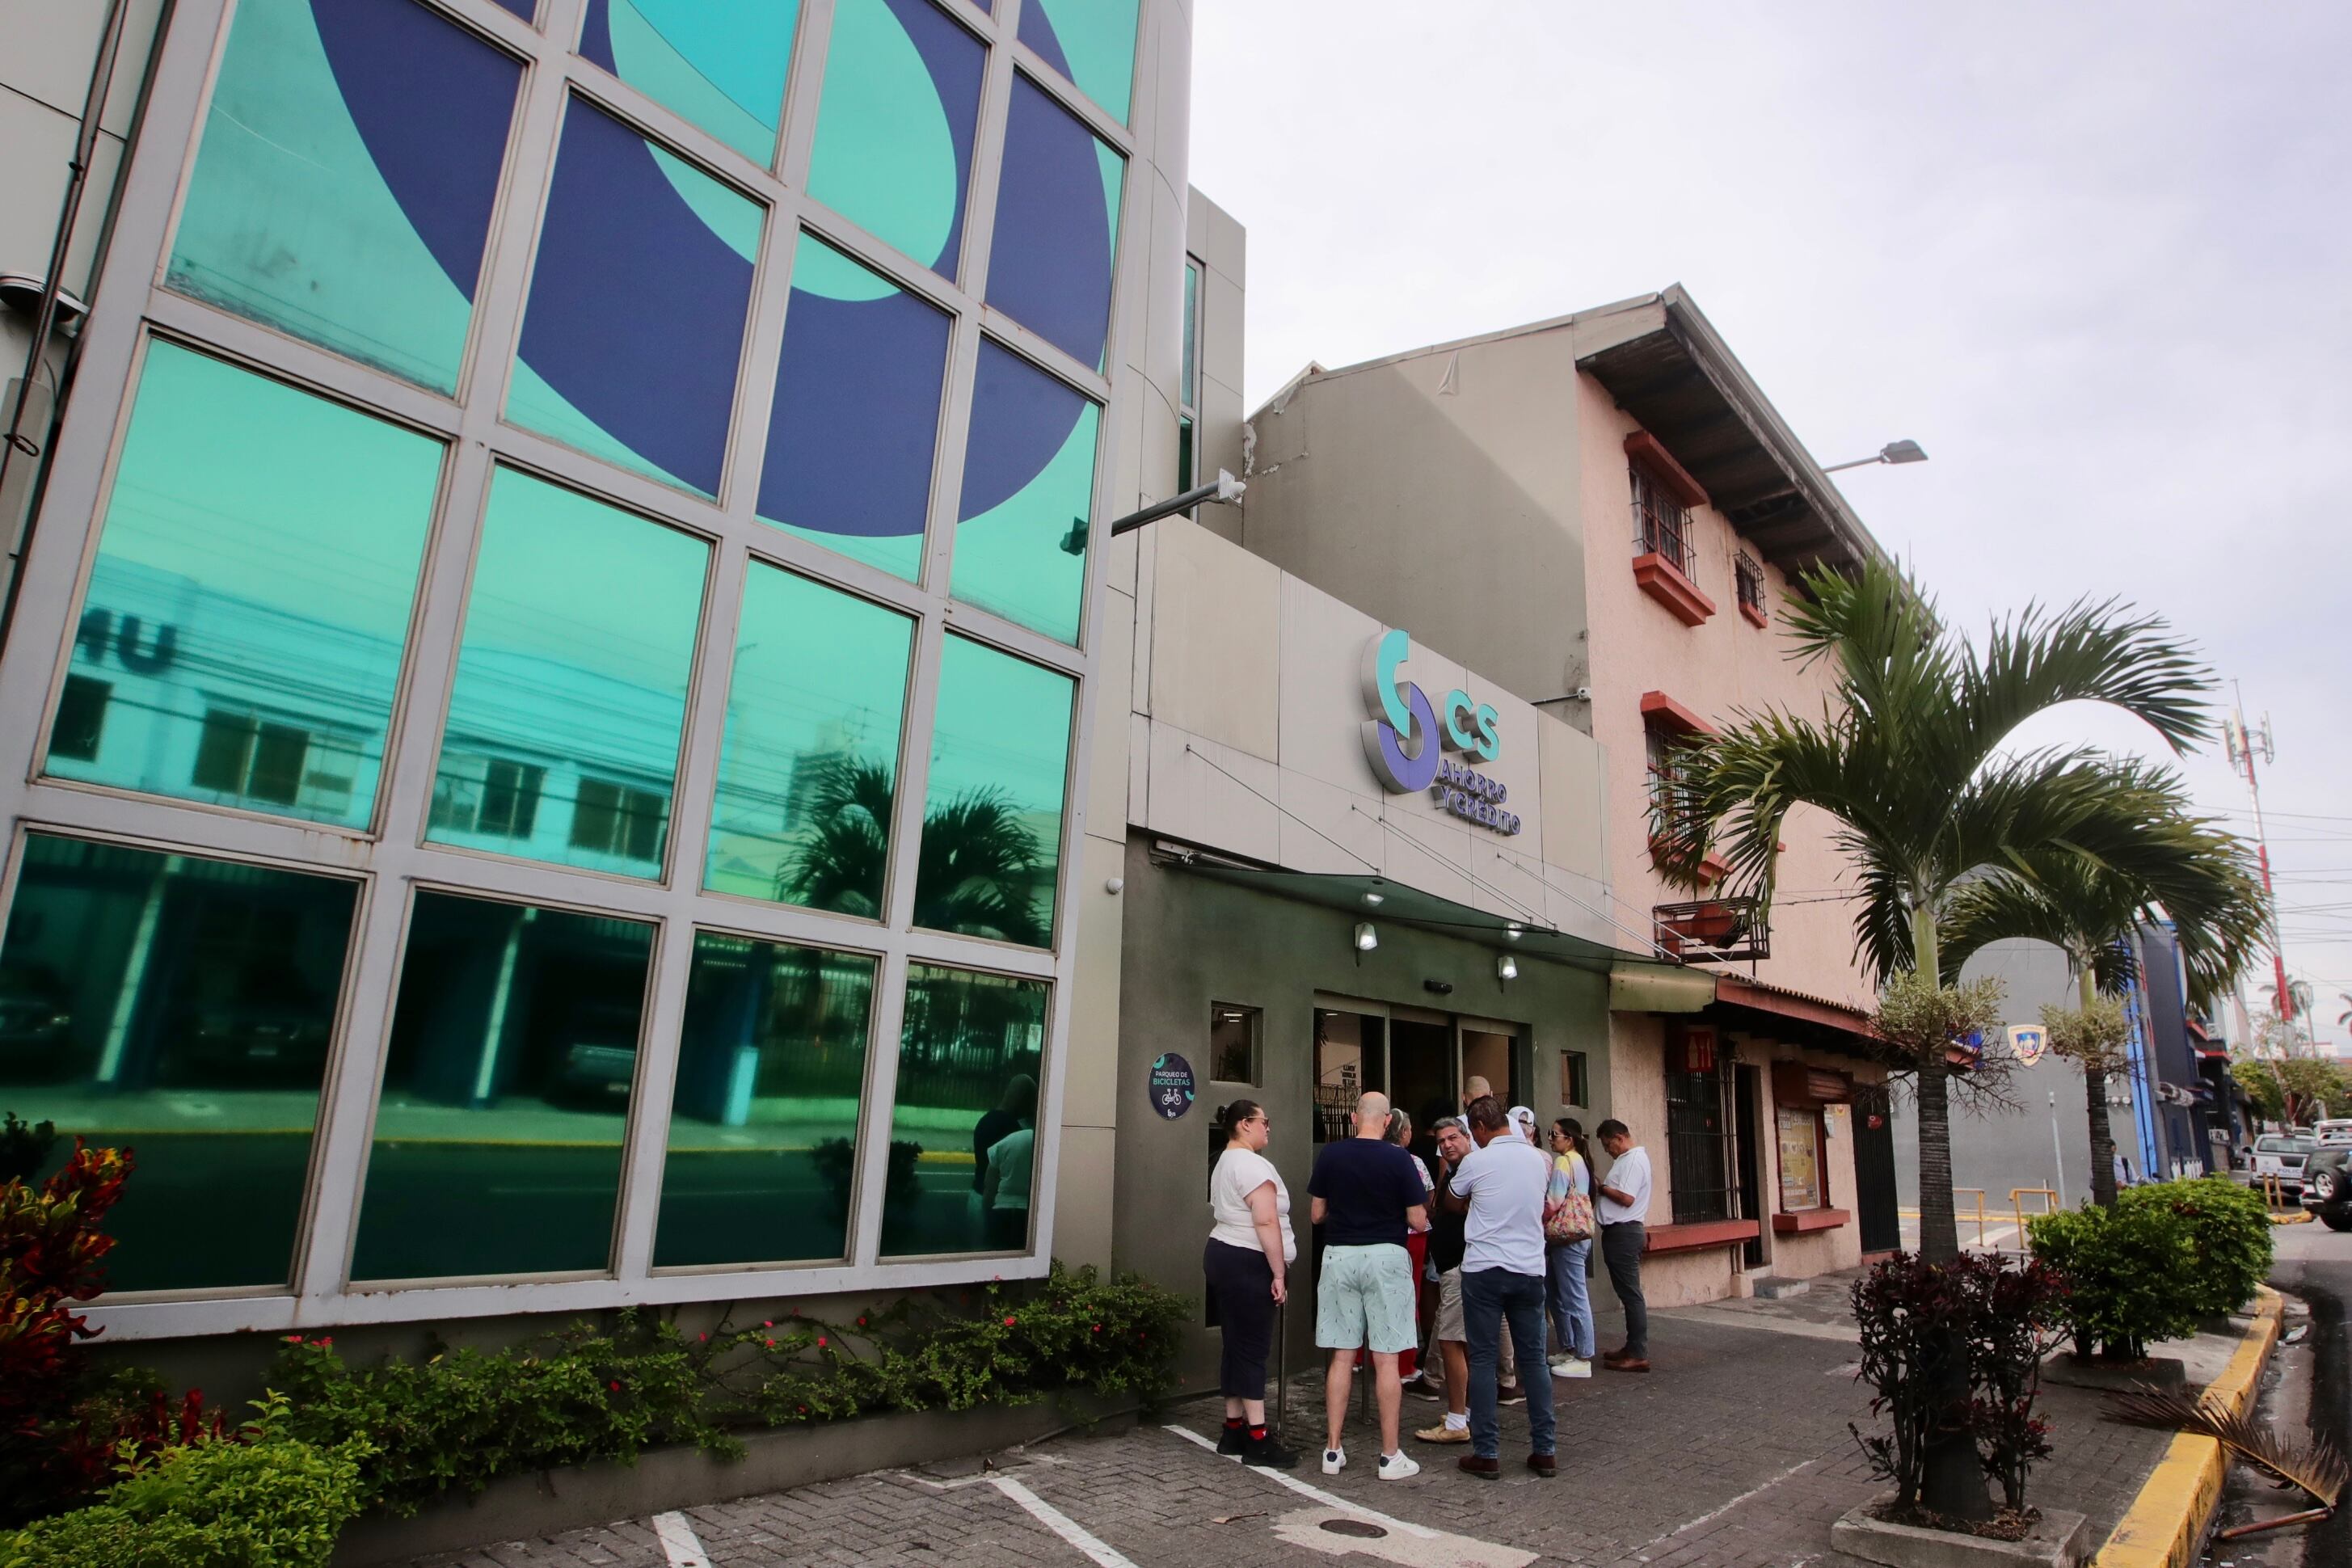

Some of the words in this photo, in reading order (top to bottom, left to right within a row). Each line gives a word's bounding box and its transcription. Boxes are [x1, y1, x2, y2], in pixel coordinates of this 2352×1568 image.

[1440, 759, 1507, 803] AHORRO
[1440, 785, 1452, 809] Y
[1455, 792, 1520, 835] CRÉDITO
